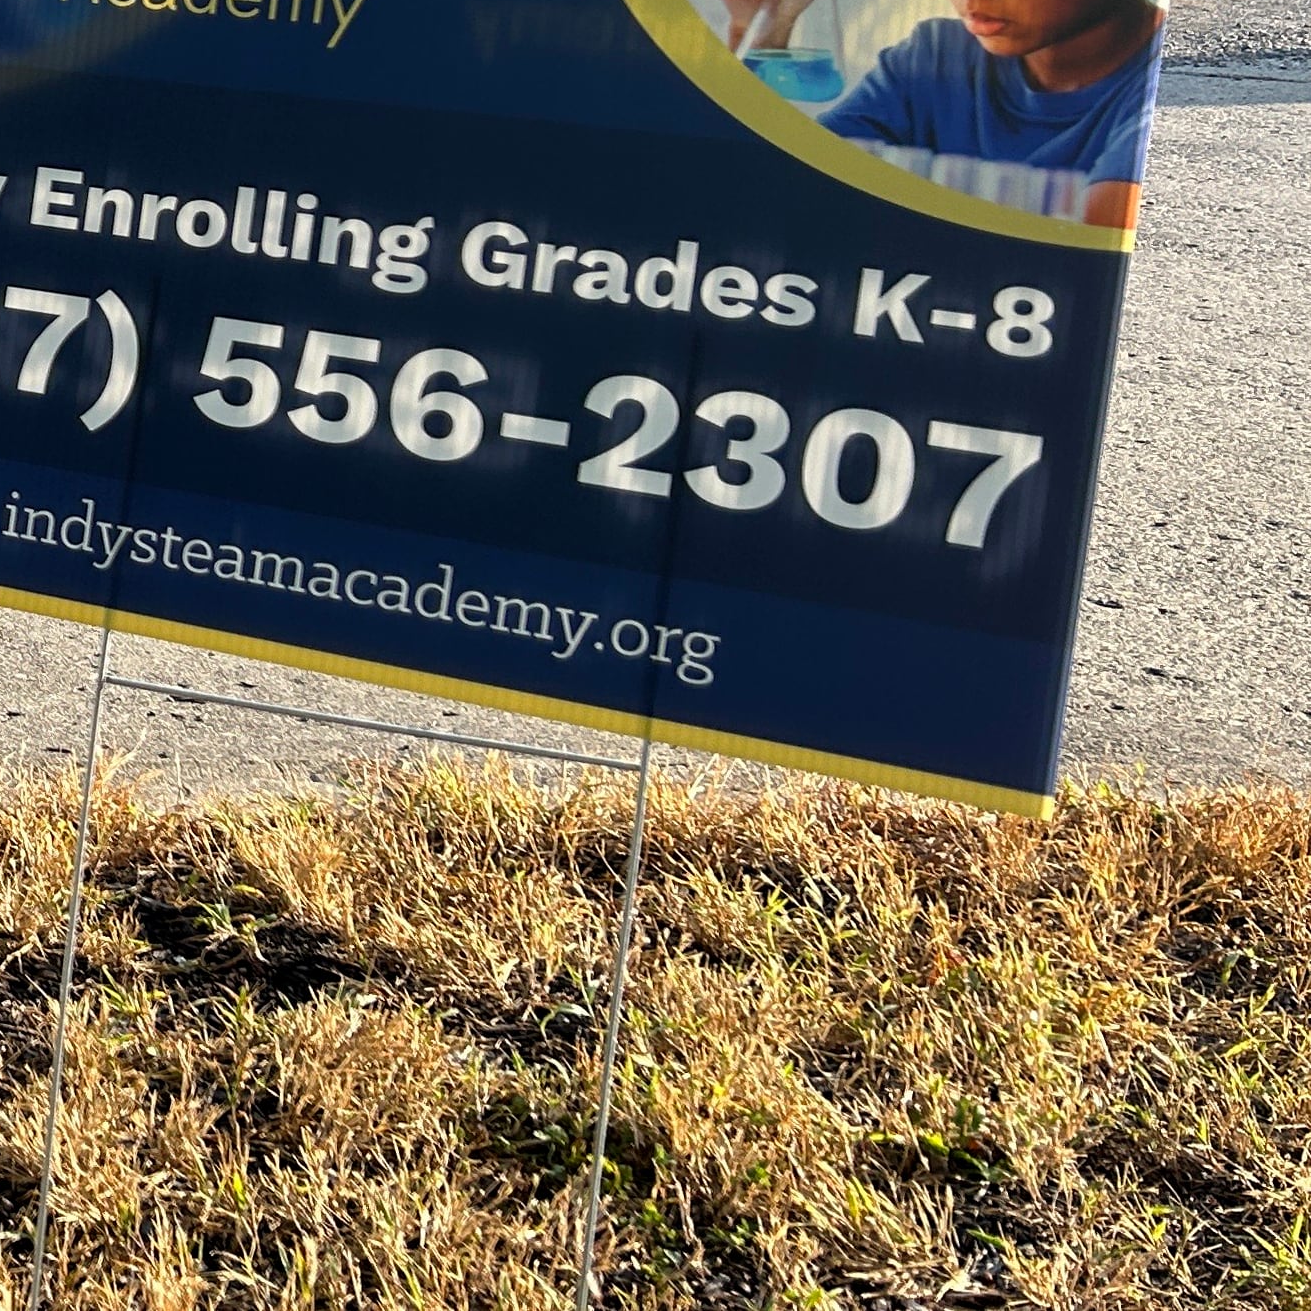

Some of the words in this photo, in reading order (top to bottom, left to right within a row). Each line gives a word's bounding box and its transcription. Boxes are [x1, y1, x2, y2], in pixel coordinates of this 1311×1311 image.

[29, 166, 435, 294] Enrolling
[460, 221, 818, 327] Grades
[853, 267, 1055, 358] K-8
[192, 316, 1044, 548] 556-2307
[1, 491, 721, 686] indysteamacademy.org
